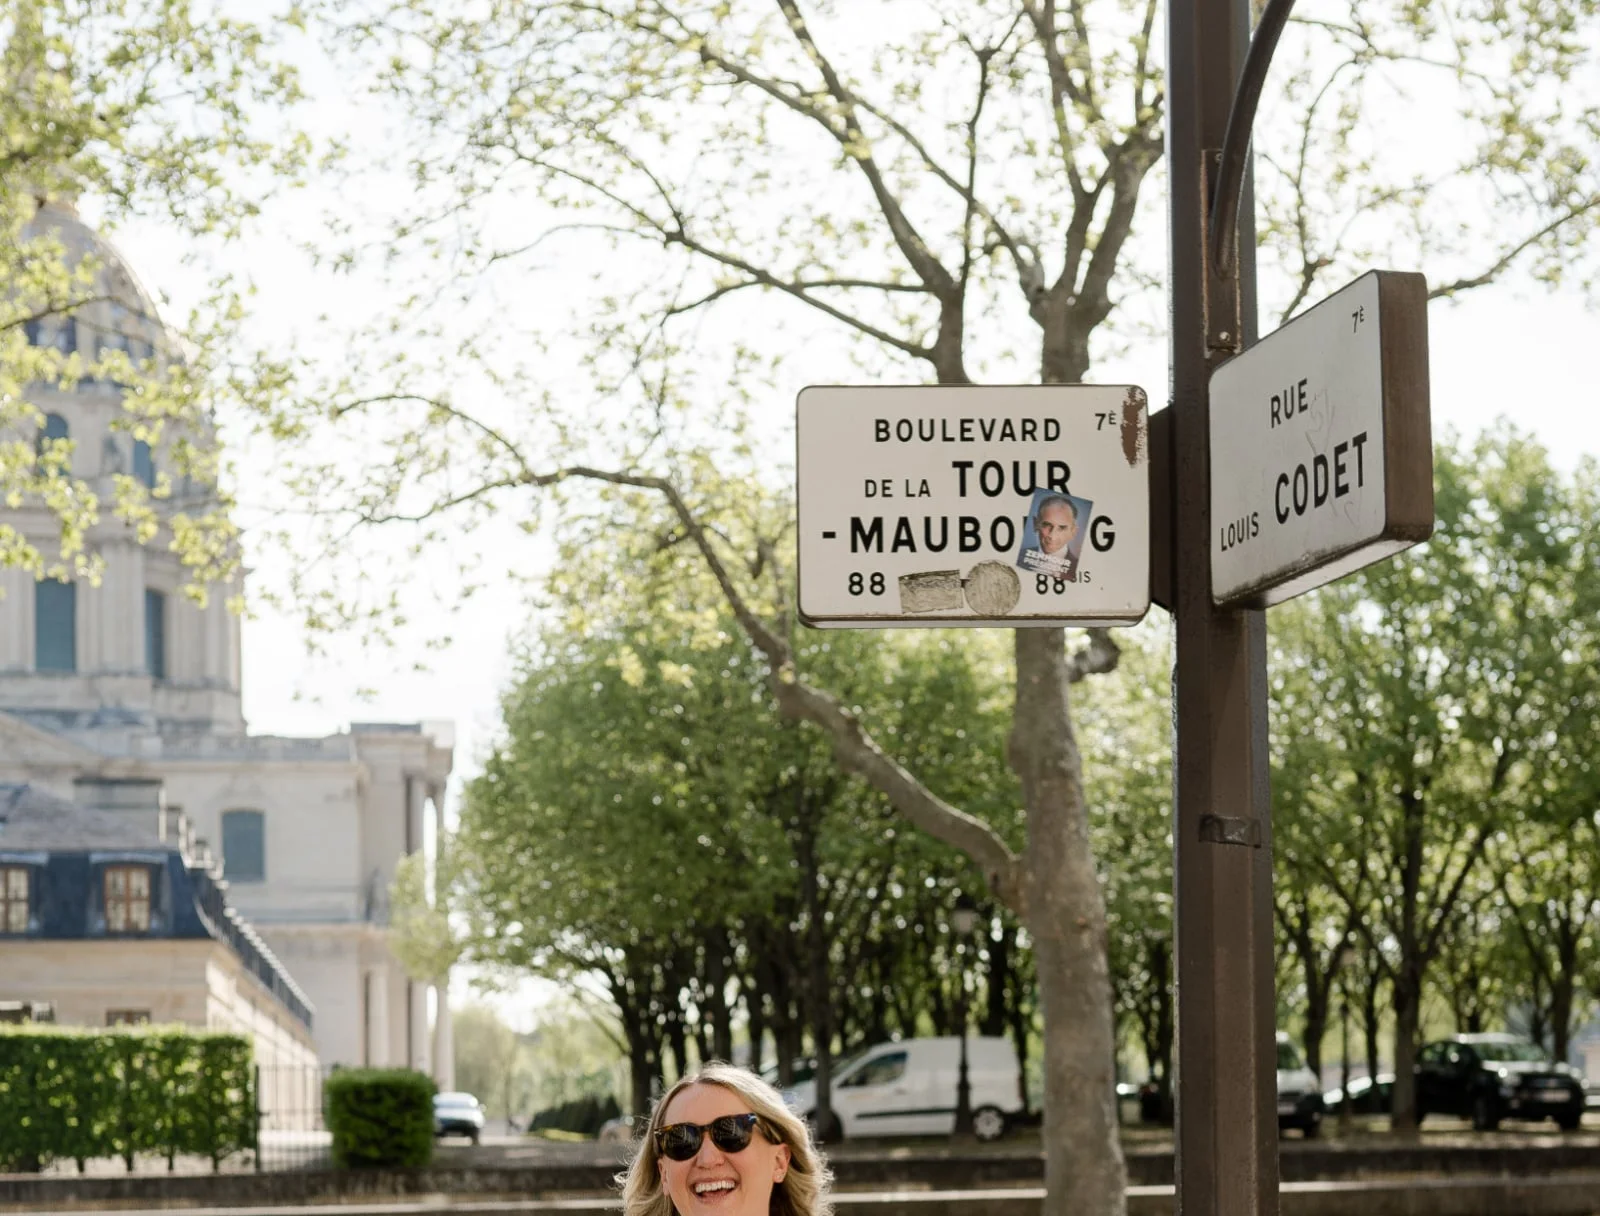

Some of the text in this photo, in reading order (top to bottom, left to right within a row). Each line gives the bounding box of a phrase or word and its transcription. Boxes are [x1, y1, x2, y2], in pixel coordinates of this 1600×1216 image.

[1271, 378, 1309, 428] RUE
[875, 418, 1061, 442] BOULEVARD
[864, 461, 1072, 498] DE LA TOUR
[1221, 431, 1368, 551] LOUIS CODET
[822, 515, 1116, 552] -MAUBOG
[848, 571, 886, 596] 88
[1036, 572, 1066, 595] 88
